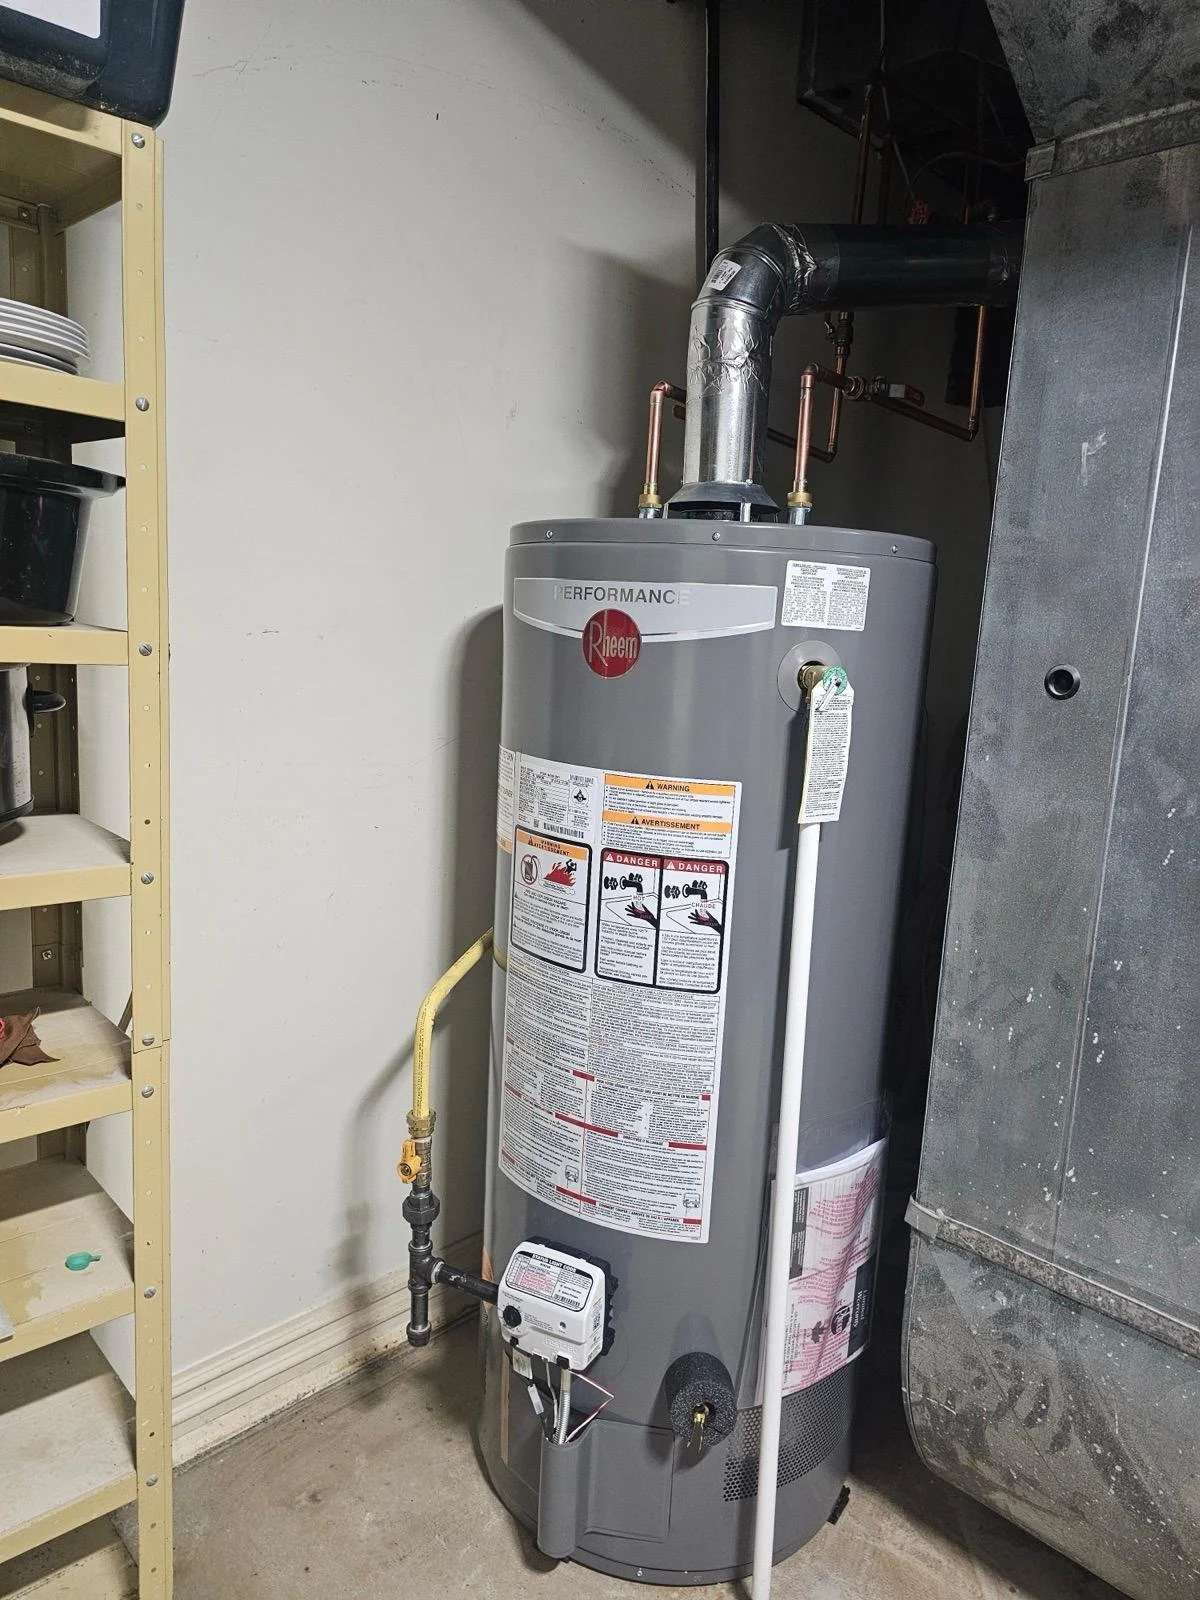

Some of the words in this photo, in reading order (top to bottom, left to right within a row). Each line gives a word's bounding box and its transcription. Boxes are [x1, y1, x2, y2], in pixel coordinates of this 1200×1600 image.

[554, 585, 691, 606] PERFORMANCE
[588, 610, 638, 666] Rheem
[656, 782, 690, 792] WARNING
[641, 818, 701, 831] AVERTISSEMENT
[616, 855, 658, 867] DANGER
[678, 861, 723, 873] DANGER
